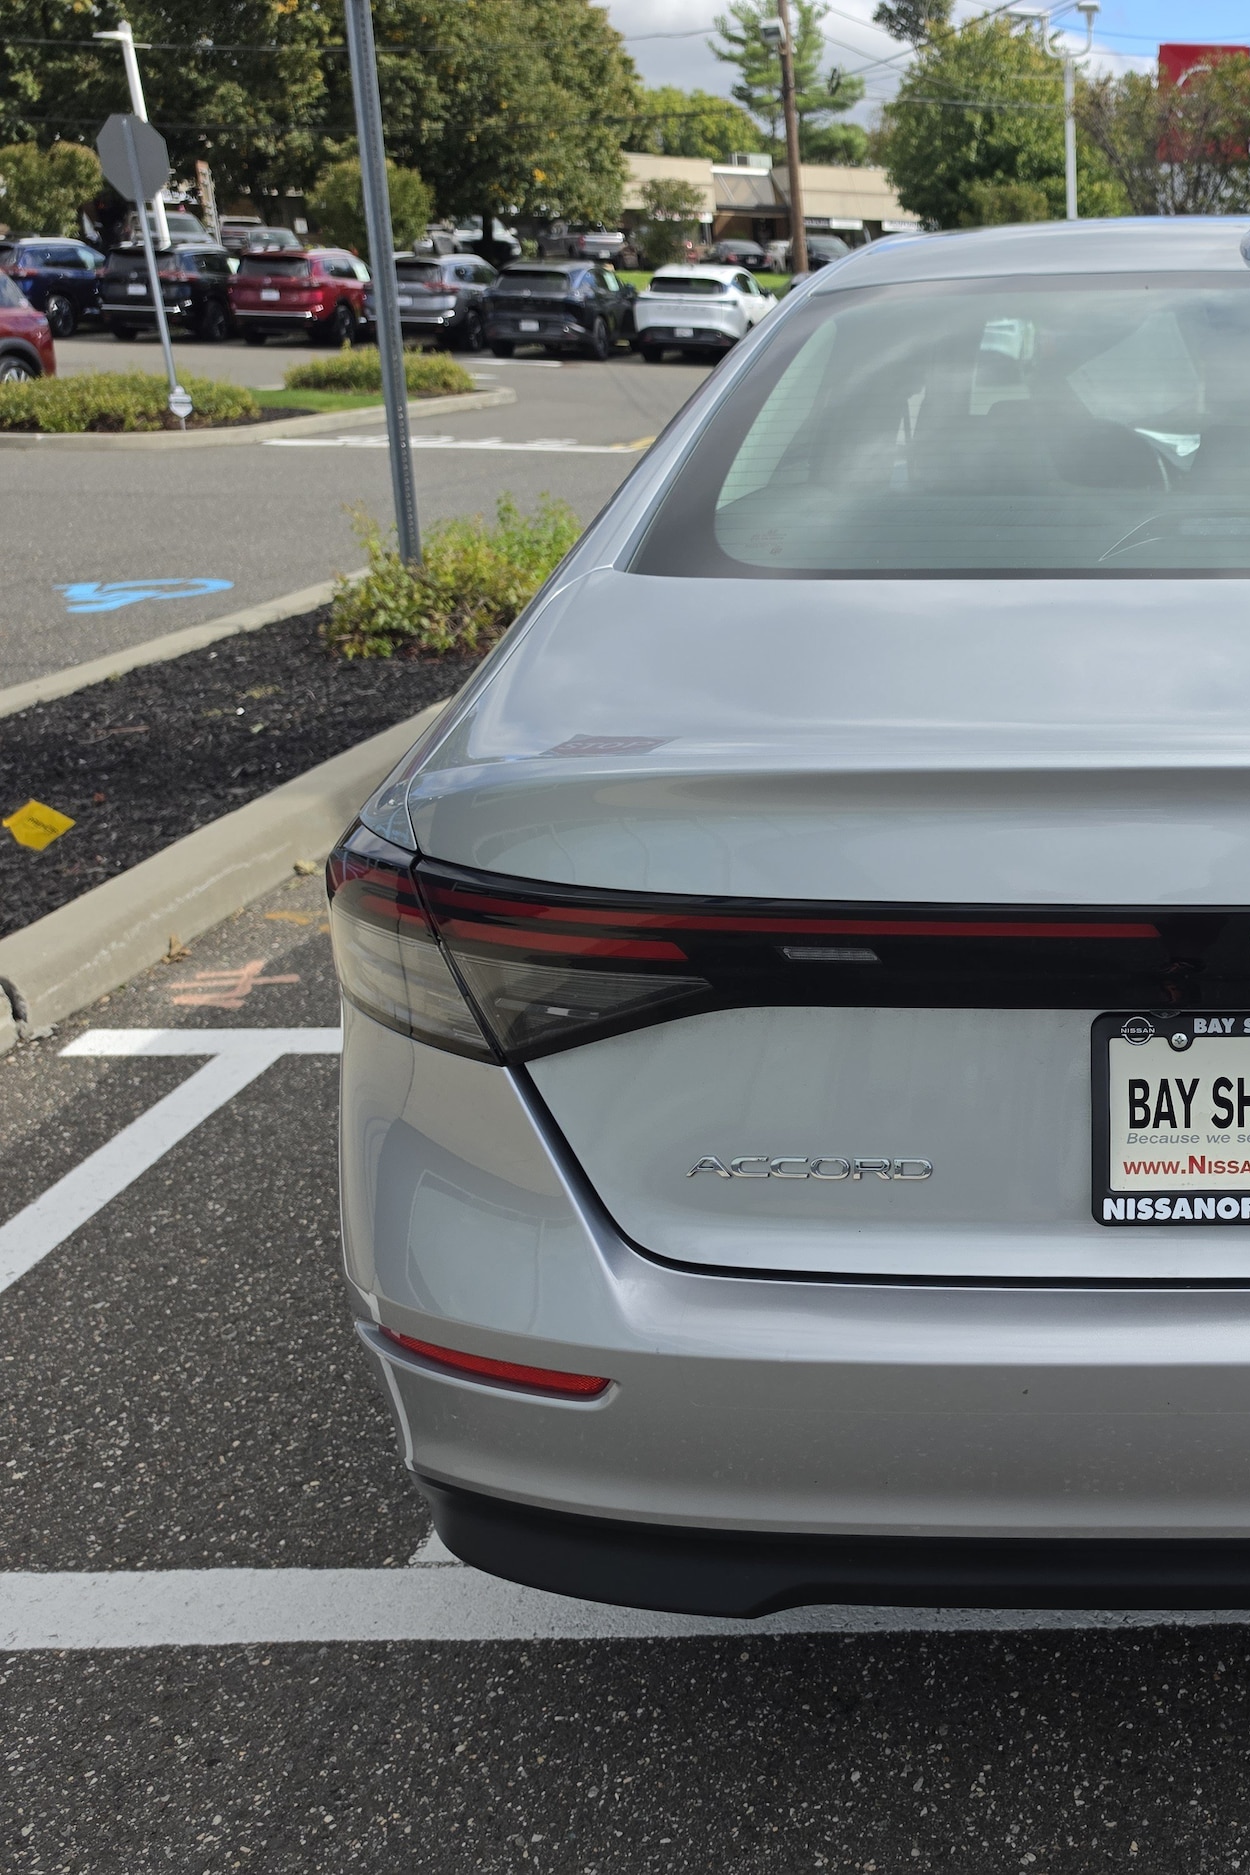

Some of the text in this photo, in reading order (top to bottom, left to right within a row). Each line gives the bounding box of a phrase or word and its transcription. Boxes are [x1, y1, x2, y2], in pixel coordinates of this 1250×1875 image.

[558, 741, 656, 750] STOP
[1120, 1026, 1156, 1034] NISSAN
[1193, 1017, 1236, 1034] BAY
[1128, 1078, 1200, 1129] BAY
[1126, 1132, 1200, 1145] Because
[1206, 1134, 1231, 1144] we
[685, 1154, 934, 1180] ACCORD
